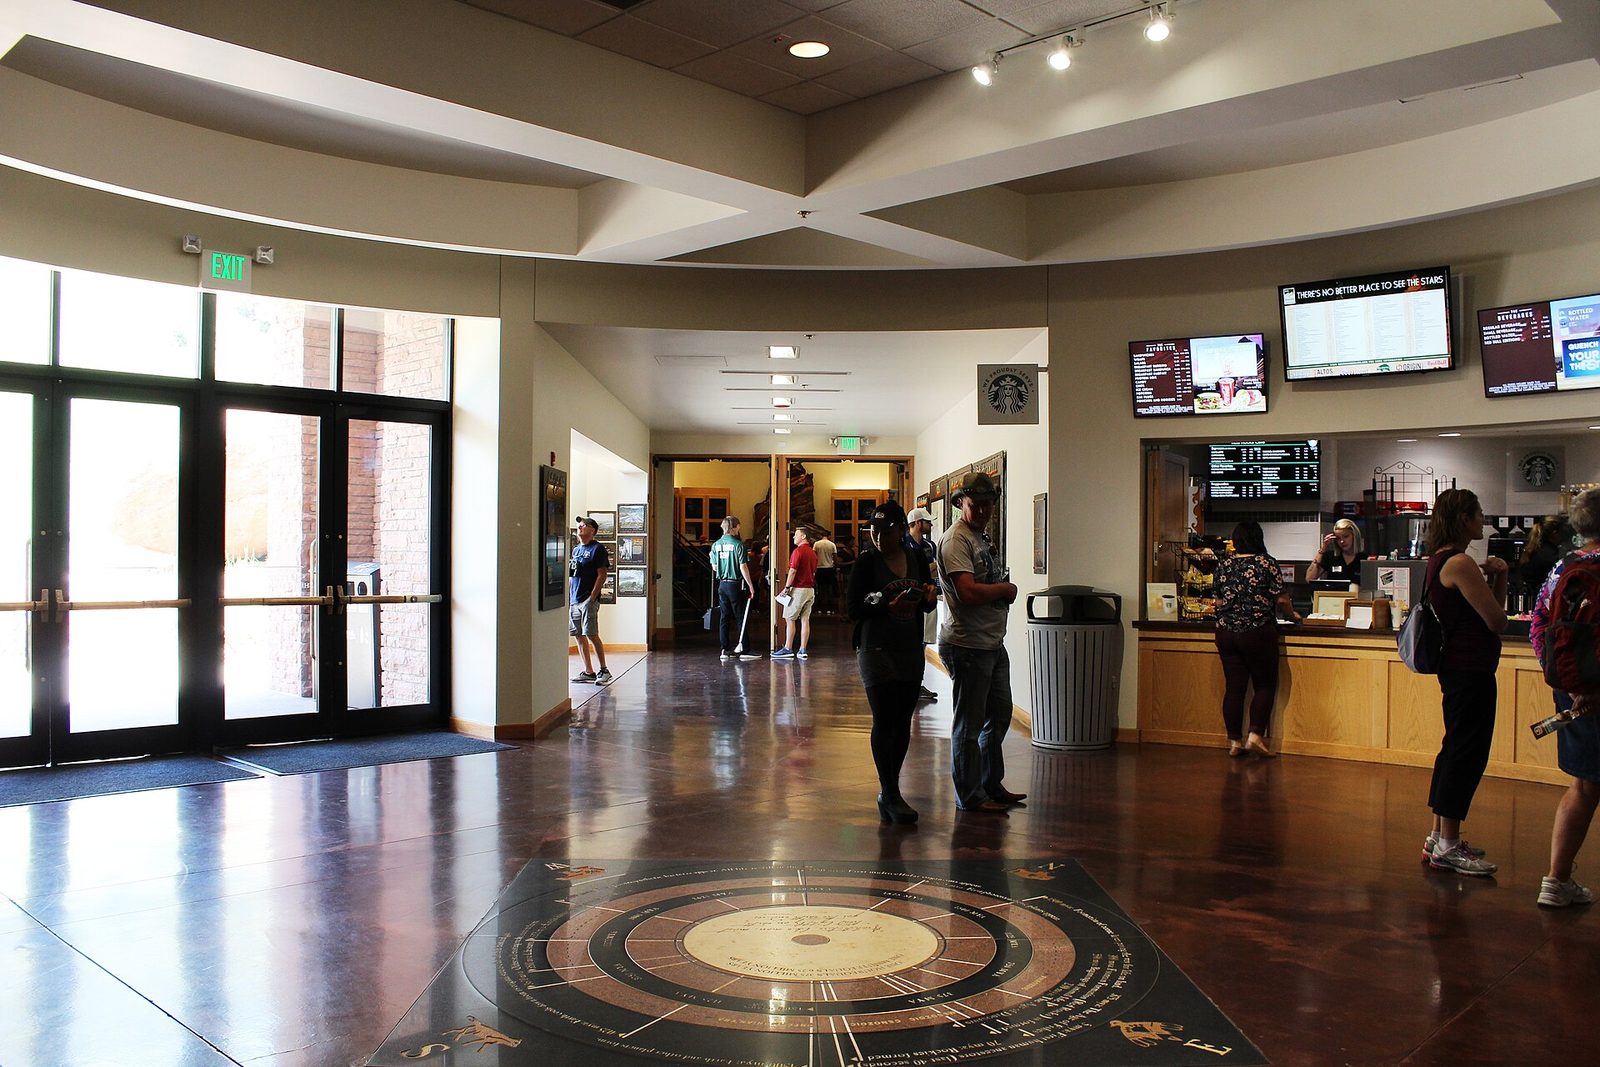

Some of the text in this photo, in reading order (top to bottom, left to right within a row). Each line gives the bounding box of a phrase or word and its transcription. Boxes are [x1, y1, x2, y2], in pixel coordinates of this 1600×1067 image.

[211, 252, 245, 281] EXIT
[1297, 289, 1321, 299] THERE'S
[1322, 288, 1334, 296] NO
[1336, 284, 1357, 295] BETTER
[1359, 283, 1379, 293] PLACE
[1393, 280, 1405, 288] SEE
[1407, 278, 1419, 287] THE
[1421, 276, 1443, 285] STARS
[1498, 312, 1533, 321] BEVERAGES
[1569, 313, 1589, 321] WATER
[1568, 341, 1599, 350] QUENCH
[1569, 351, 1600, 361] YOUR
[1403, 363, 1421, 371] ORIGIN
[1569, 361, 1600, 371] THIRST
[983, 367, 1034, 388] WE PROUDLY SERVE
[755, 963, 794, 972] MILLION
[816, 964, 855, 972] EQUALS
[756, 968, 799, 977] MILLION
[905, 995, 937, 1004] MYA
[618, 1042, 657, 1053] planets
[1006, 1038, 1045, 1050] human
[1182, 1037, 1233, 1057] E
[911, 1046, 960, 1057] Rockies
[956, 1045, 1010, 1059] ancestors
[866, 1052, 912, 1061] formed
[928, 1054, 960, 1063] (last
[856, 1059, 912, 1067] seconds)
